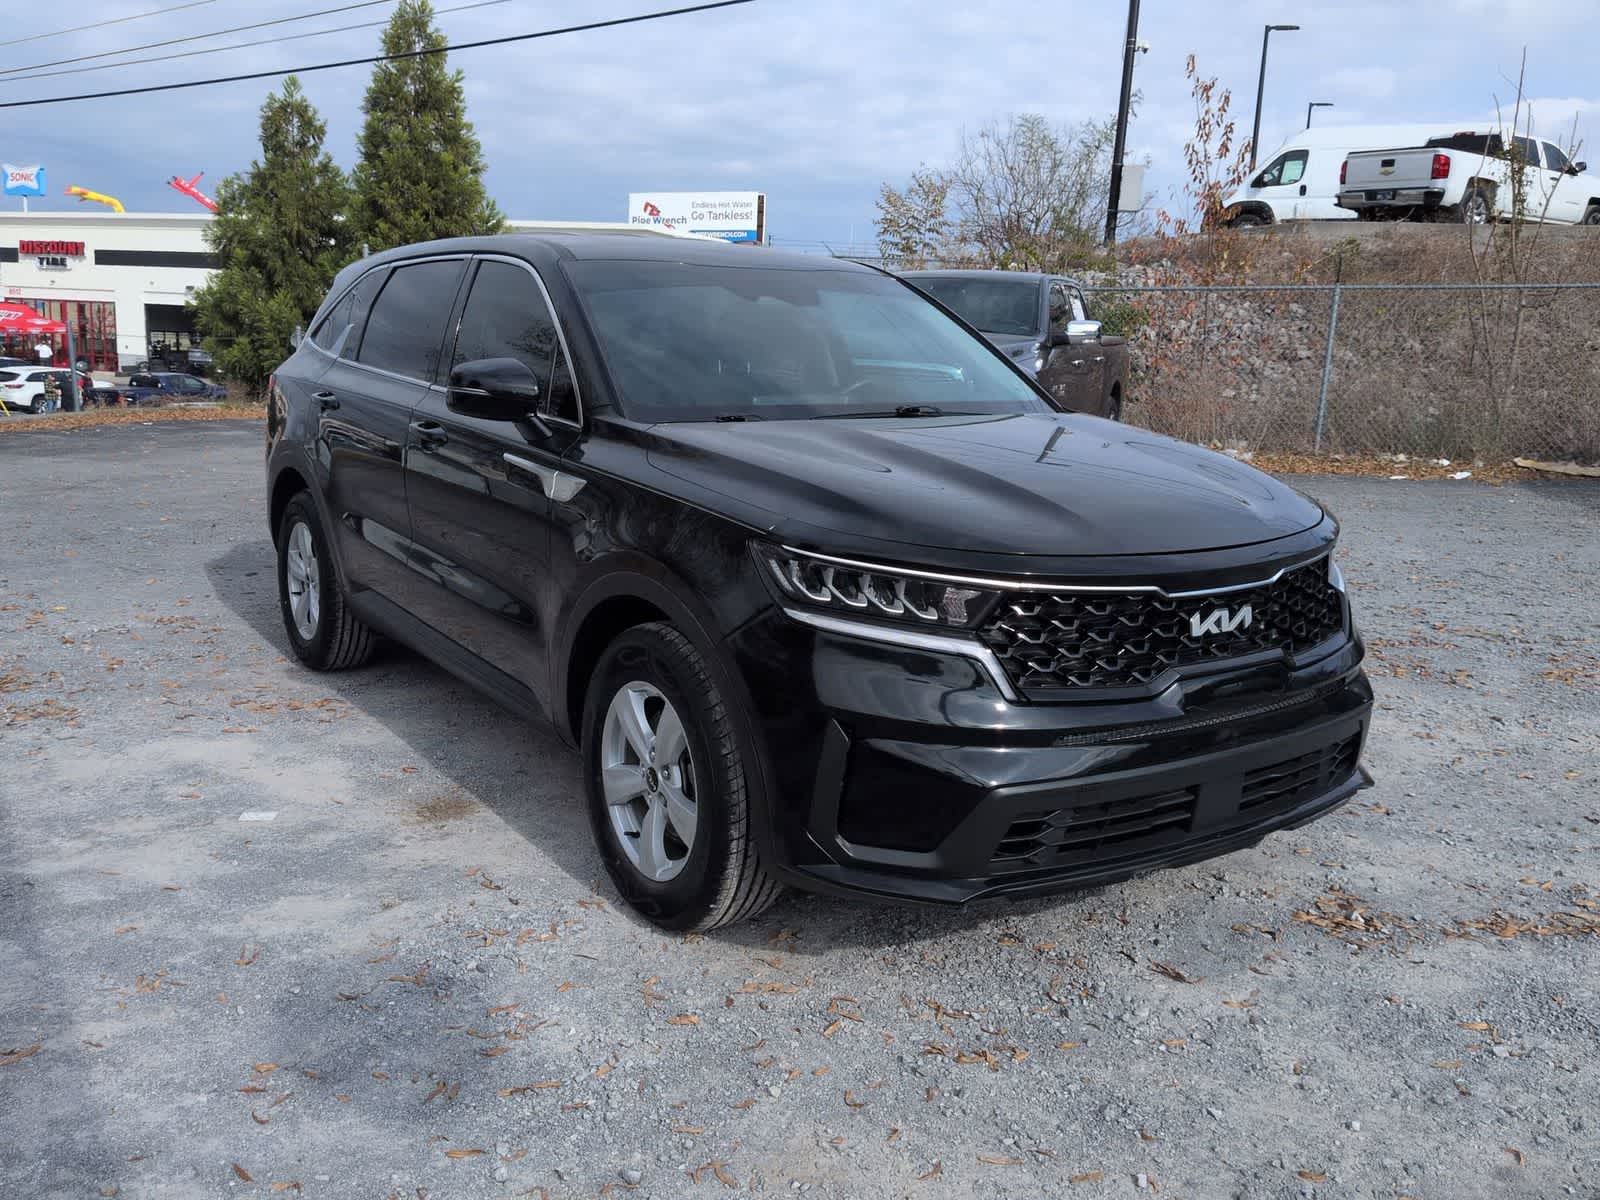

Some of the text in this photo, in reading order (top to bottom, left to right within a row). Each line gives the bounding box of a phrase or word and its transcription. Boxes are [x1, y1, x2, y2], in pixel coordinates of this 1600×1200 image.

[10, 171, 35, 182] SONIC
[652, 216, 687, 224] Wrench
[691, 210, 752, 220] Go Tankless!
[19, 240, 85, 256] DISCOUNT
[38, 256, 67, 267] TIRE
